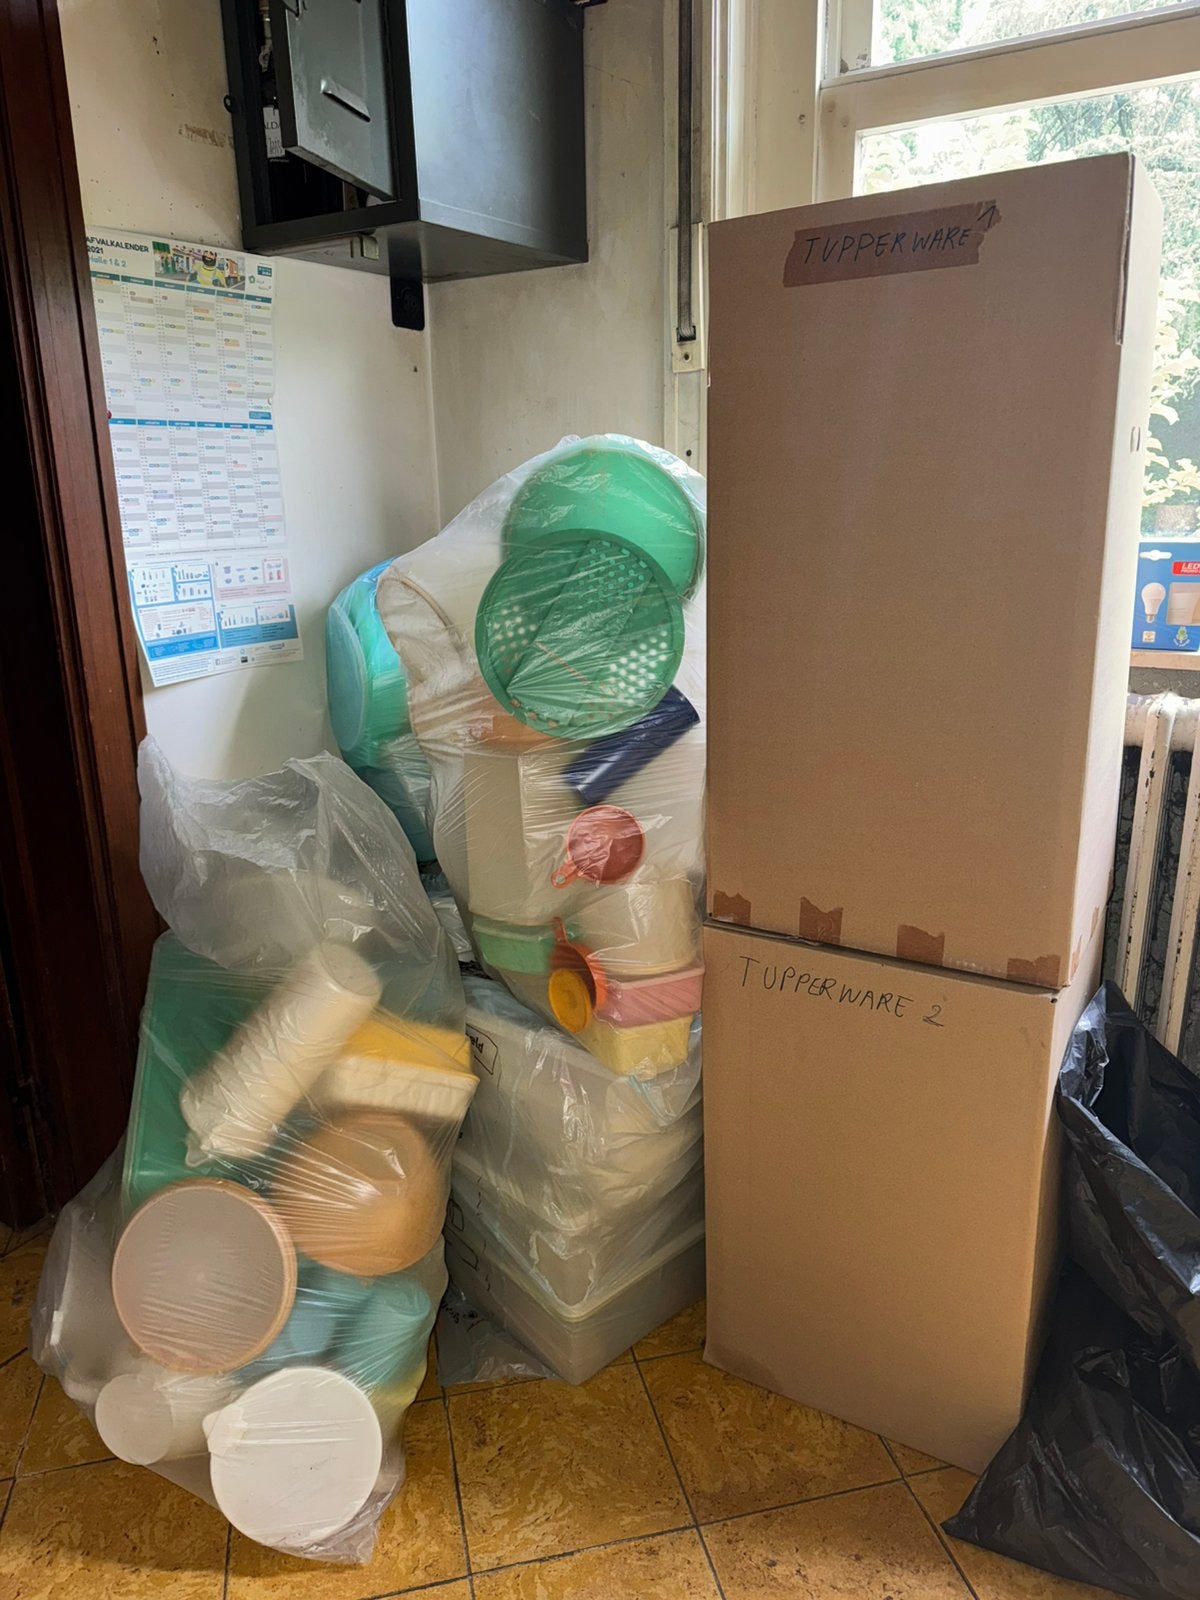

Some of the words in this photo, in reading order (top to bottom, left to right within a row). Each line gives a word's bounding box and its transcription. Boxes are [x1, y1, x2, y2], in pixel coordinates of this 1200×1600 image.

[804, 227, 971, 264] TUPPERWARE
[977, 205, 997, 229] 1
[739, 956, 914, 1018] TUPPERWARE
[922, 1004, 944, 1027] 2
